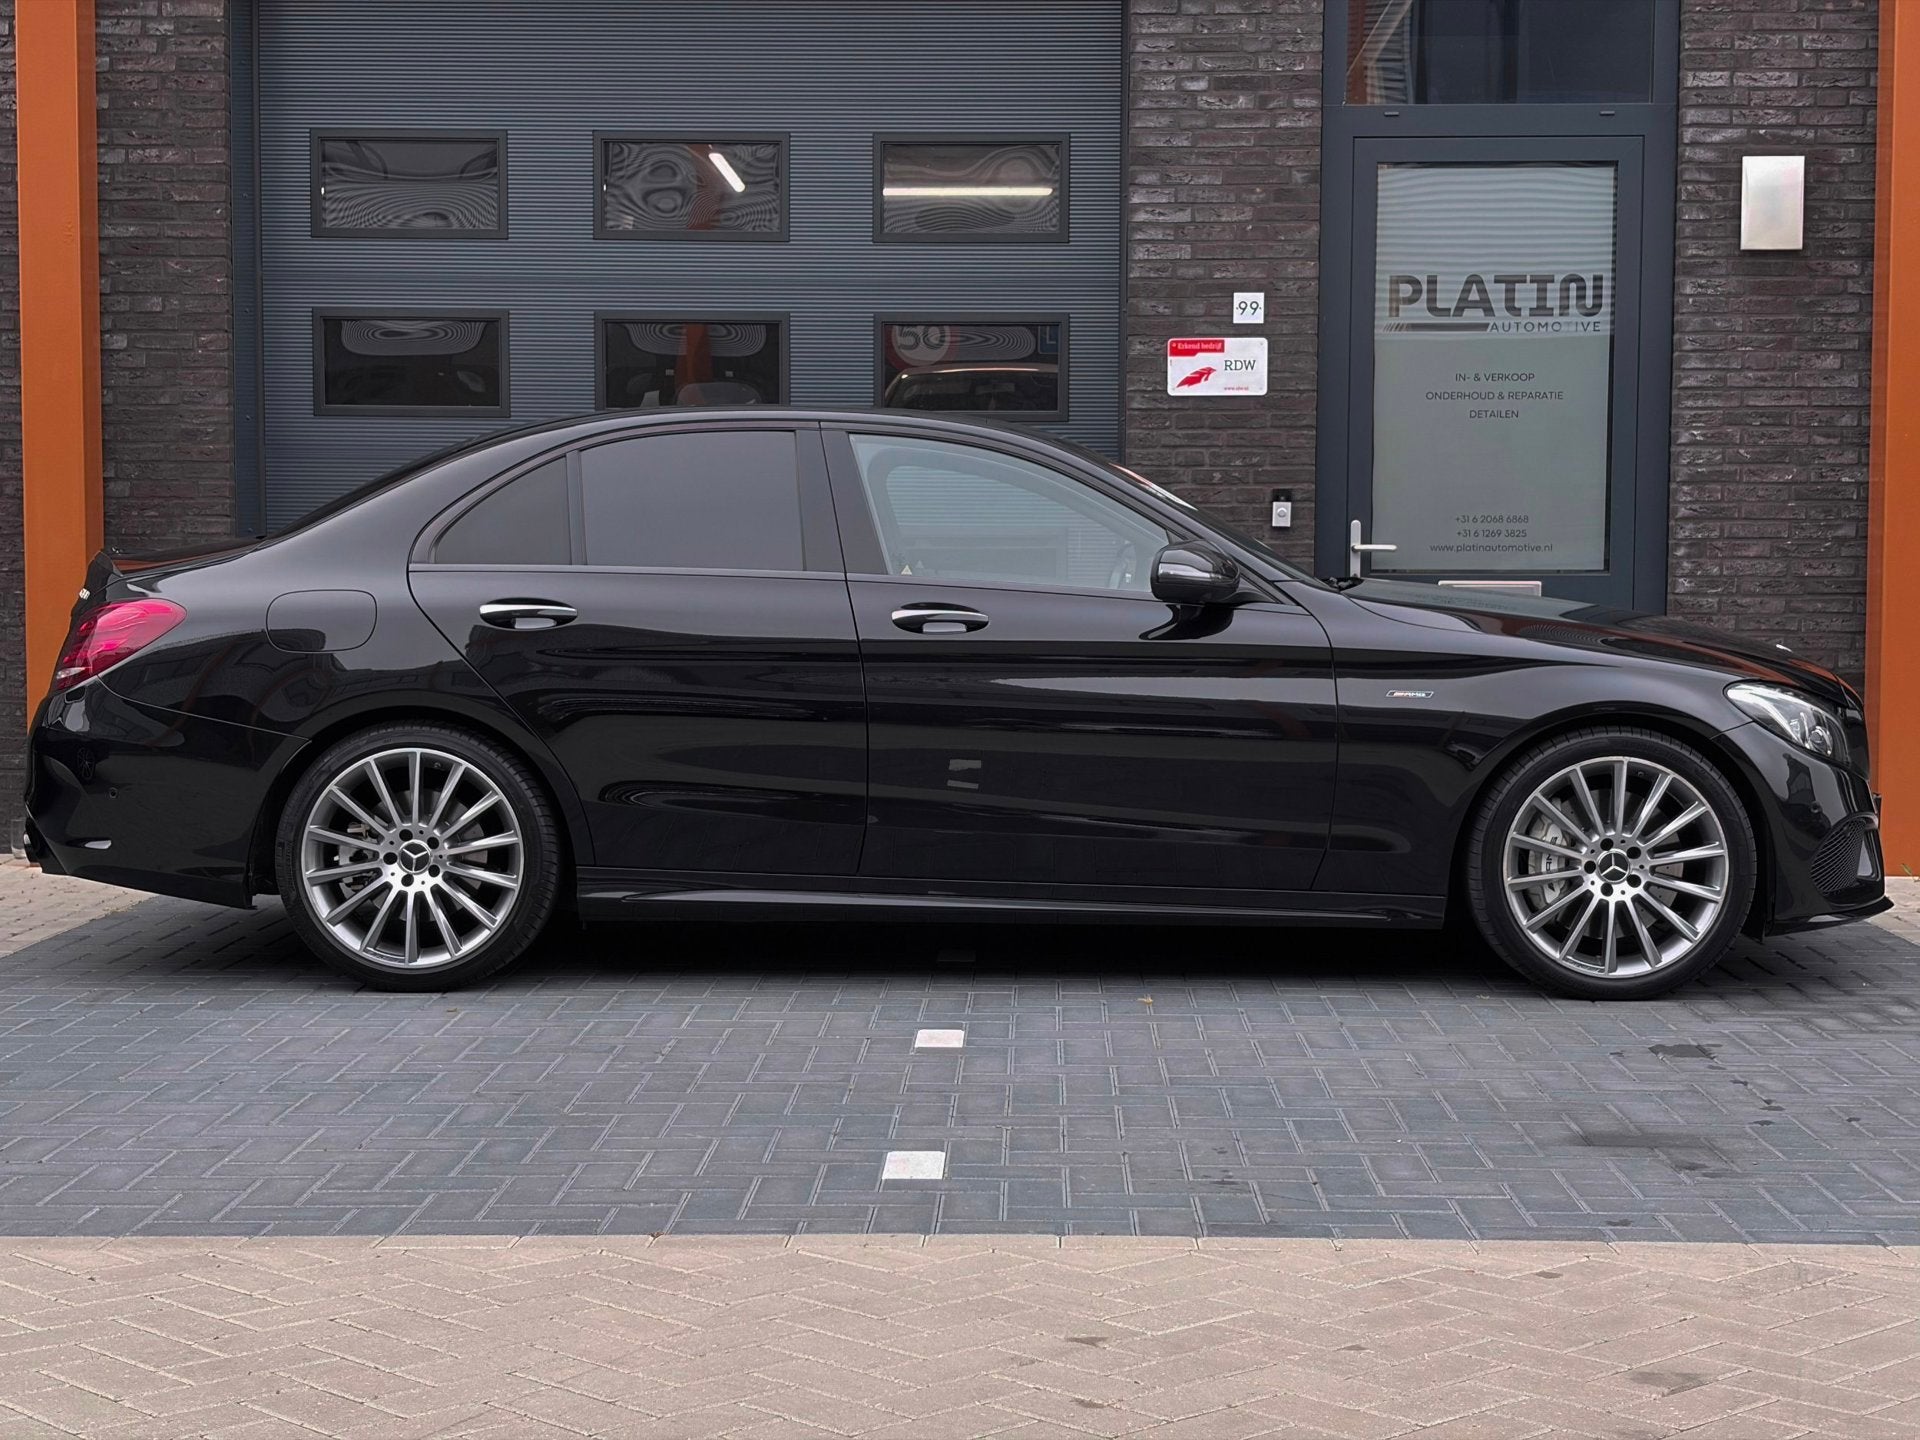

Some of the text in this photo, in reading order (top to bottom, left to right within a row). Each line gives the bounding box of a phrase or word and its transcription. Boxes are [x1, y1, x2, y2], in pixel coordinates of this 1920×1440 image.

[1388, 273, 1604, 318] PLATIN
[1238, 300, 1259, 316] 99
[1224, 359, 1257, 371] RDW
[1455, 373, 1535, 382] IN- & VERKOOP
[1425, 391, 1564, 401] ONDERHOUD & REPARATIE
[1469, 410, 1519, 419] DETAILEN
[1455, 515, 1529, 524] +31 6 2068 6868
[1456, 529, 1527, 538] +31 6 1269 3825
[1429, 543, 1553, 553] www.platinautomotive.nl
